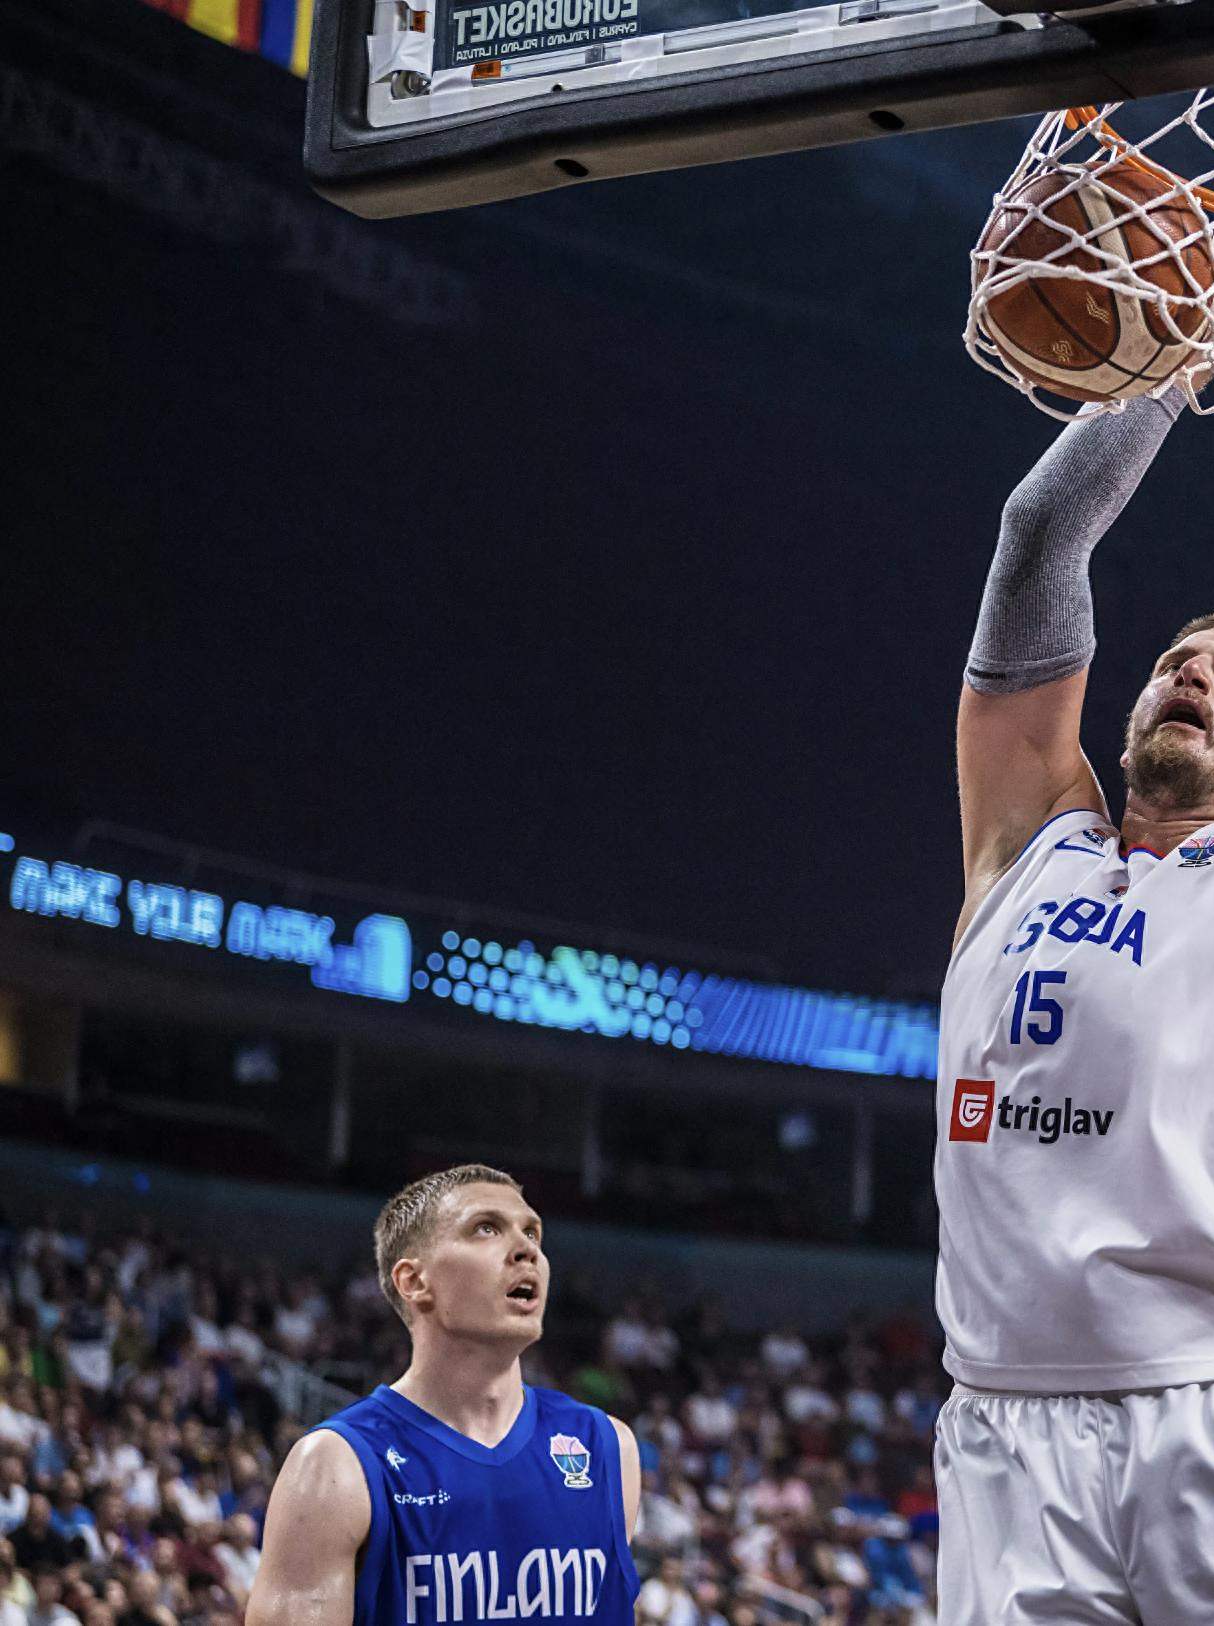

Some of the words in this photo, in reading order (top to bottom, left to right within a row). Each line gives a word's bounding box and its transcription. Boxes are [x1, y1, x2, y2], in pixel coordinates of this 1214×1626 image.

[1010, 970, 1067, 1045] 15
[998, 1095, 1114, 1144] triglav
[393, 1493, 437, 1506] CRAFT
[405, 1548, 607, 1624] FINLAND
